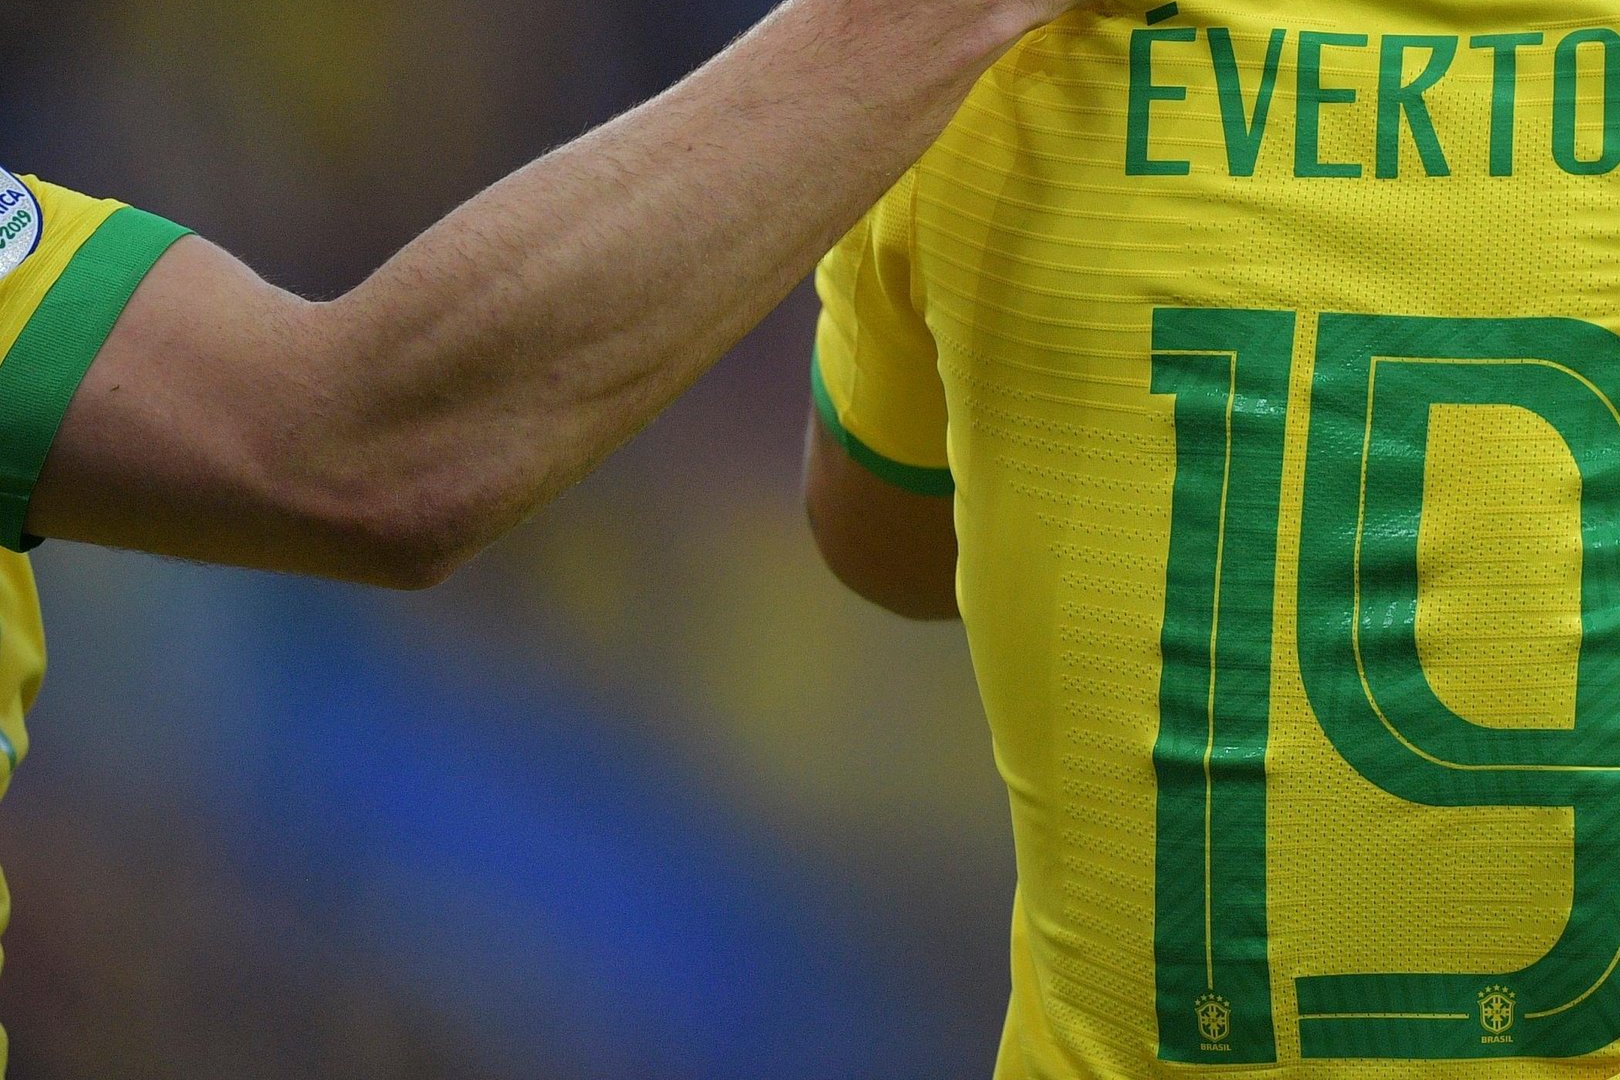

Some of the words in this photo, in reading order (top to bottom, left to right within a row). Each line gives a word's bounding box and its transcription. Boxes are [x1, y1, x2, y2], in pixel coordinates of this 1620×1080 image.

[0, 189, 25, 214] ICA
[0, 209, 31, 239] 2019
[1200, 1043, 1232, 1051] BRASIL
[1481, 1035, 1513, 1044] BRASIL
